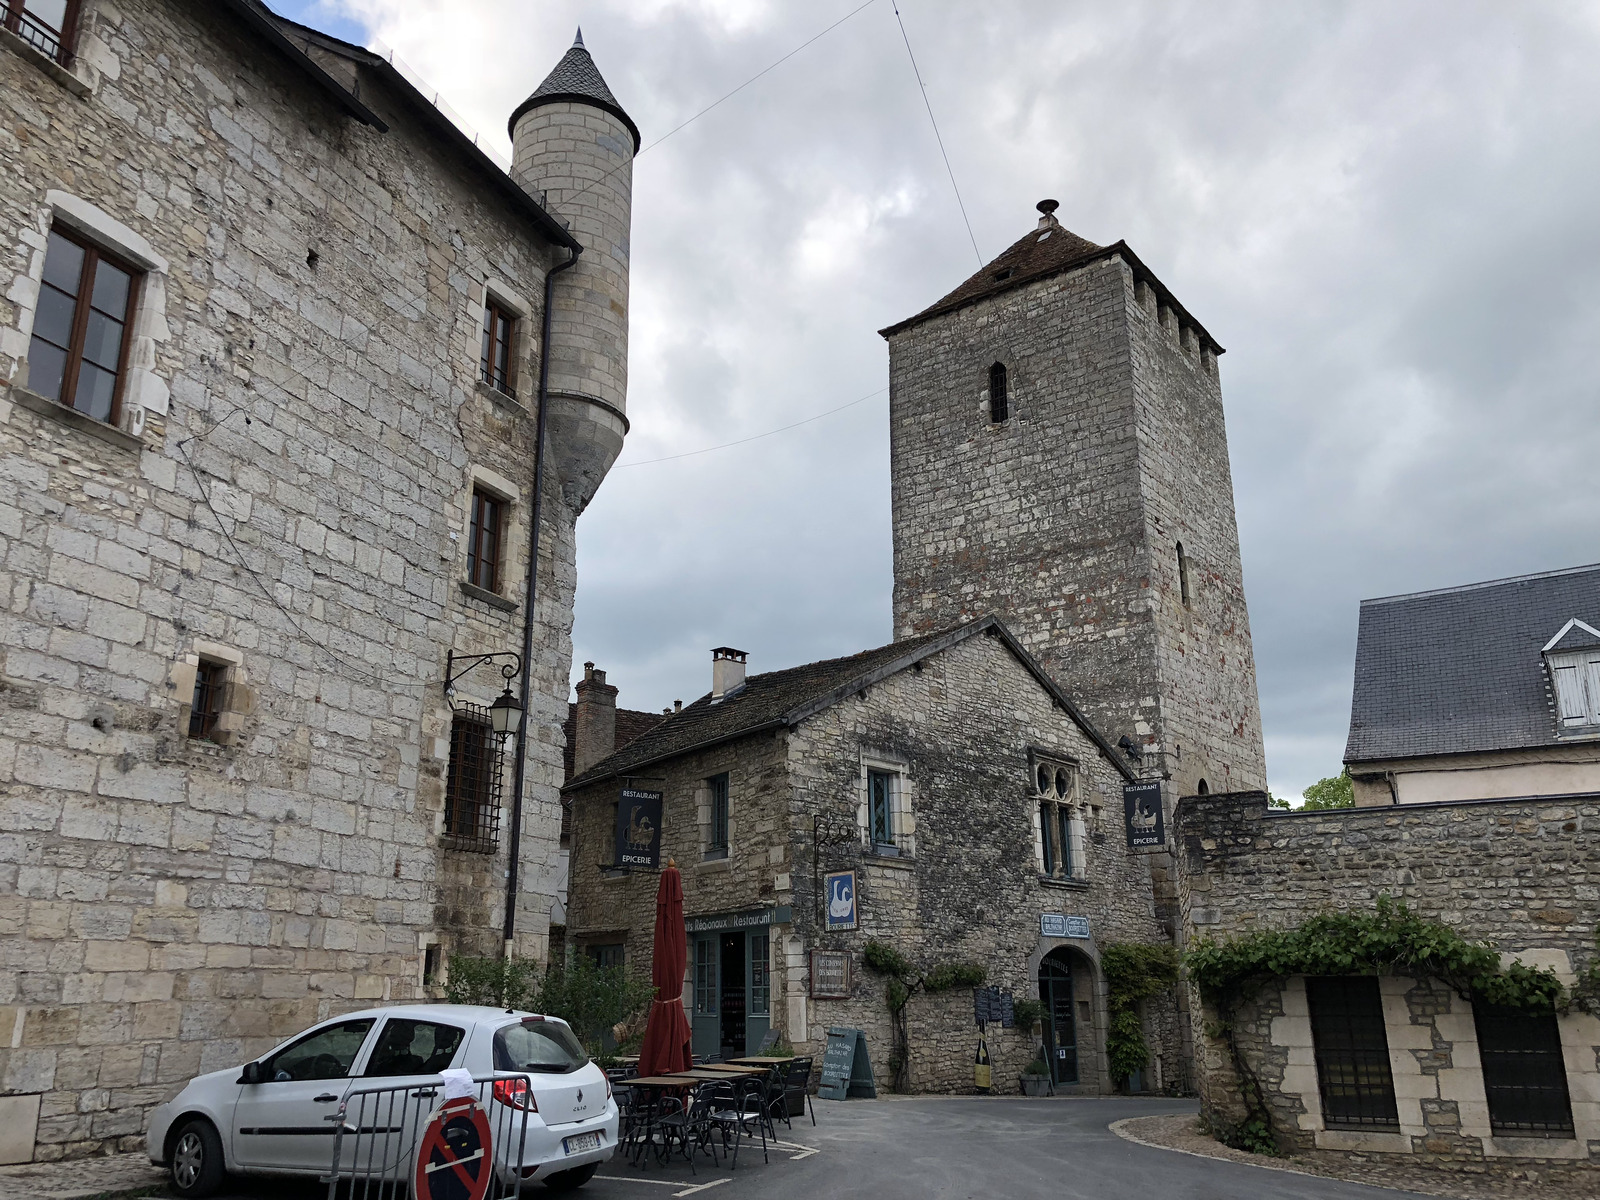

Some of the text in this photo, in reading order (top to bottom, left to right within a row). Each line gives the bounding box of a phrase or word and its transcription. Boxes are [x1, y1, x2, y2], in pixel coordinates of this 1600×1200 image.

[1125, 784, 1157, 792] RESTAURANT
[622, 790, 660, 800] RESTAURANT
[1133, 837, 1158, 845] EPICERIE
[622, 854, 652, 864] EPICERIE
[694, 918, 728, 931] Régionaux
[733, 911, 771, 927] Restaurant
